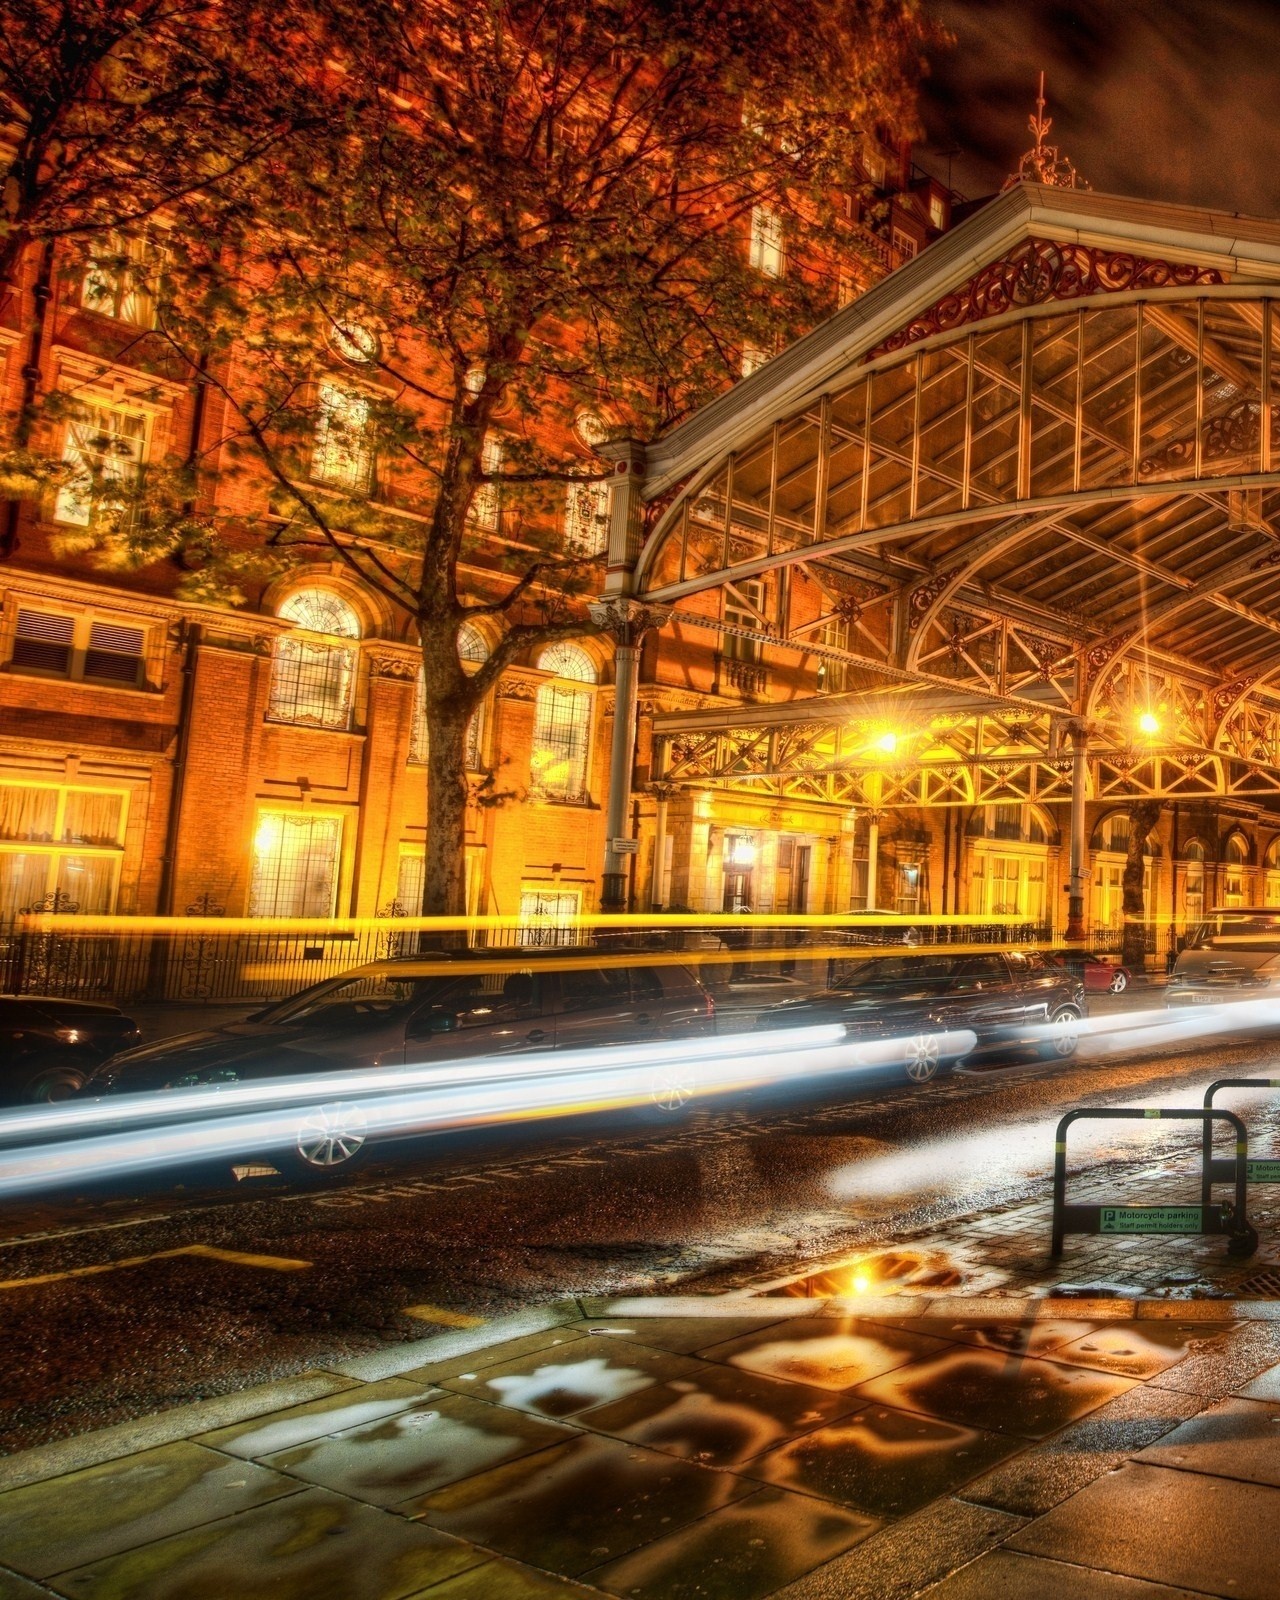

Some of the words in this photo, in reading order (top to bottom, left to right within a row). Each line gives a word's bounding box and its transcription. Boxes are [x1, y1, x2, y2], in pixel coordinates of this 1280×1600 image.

[1120, 1211, 1165, 1220] Motorcycle
[1167, 1211, 1199, 1220] parking
[1184, 1222, 1199, 1230] only
